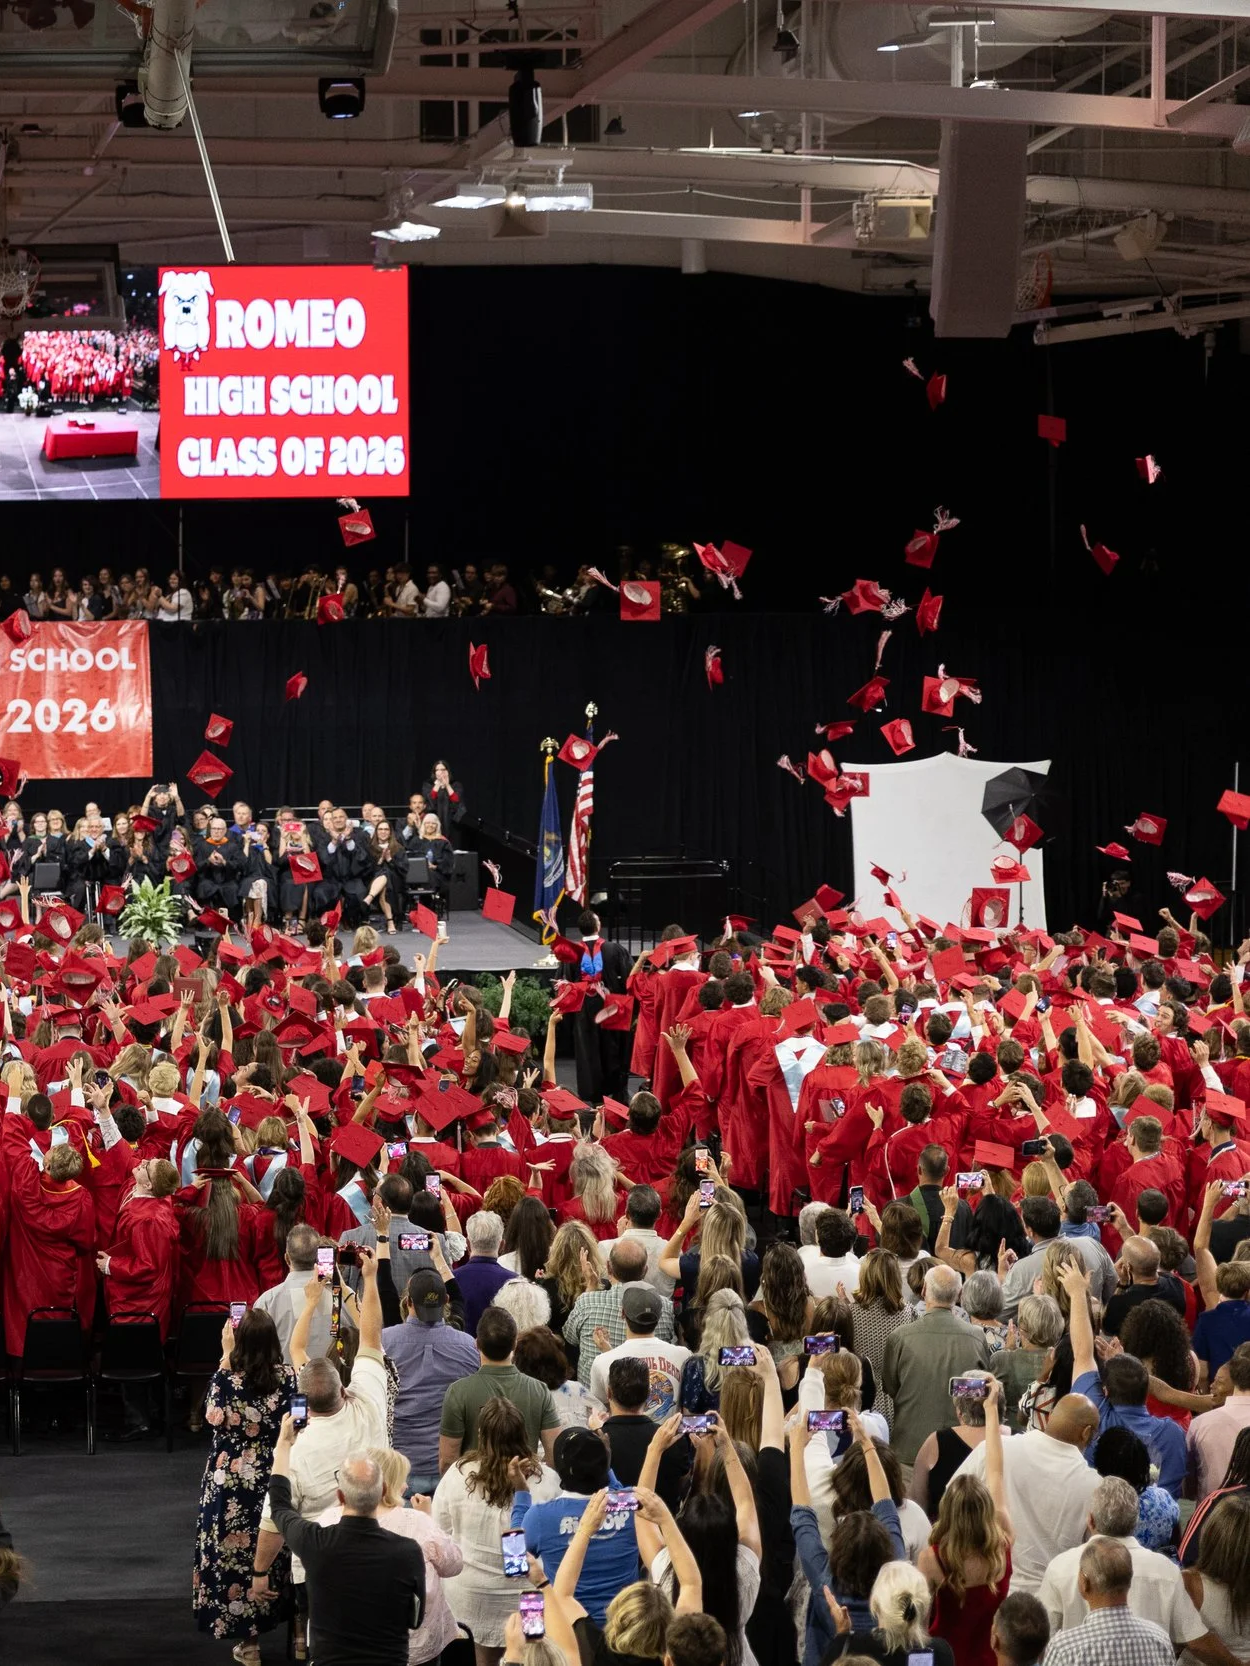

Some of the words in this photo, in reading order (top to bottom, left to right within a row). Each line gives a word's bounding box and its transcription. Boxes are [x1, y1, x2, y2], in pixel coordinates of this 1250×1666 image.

[215, 297, 366, 349] ROMEO
[183, 375, 266, 416] HIGH
[269, 374, 399, 416] SCHOOL
[177, 437, 278, 478] CLASS
[280, 436, 326, 477] OF
[327, 435, 406, 476] 2026
[9, 646, 137, 672] SCHOOL
[6, 697, 117, 734] 2026
